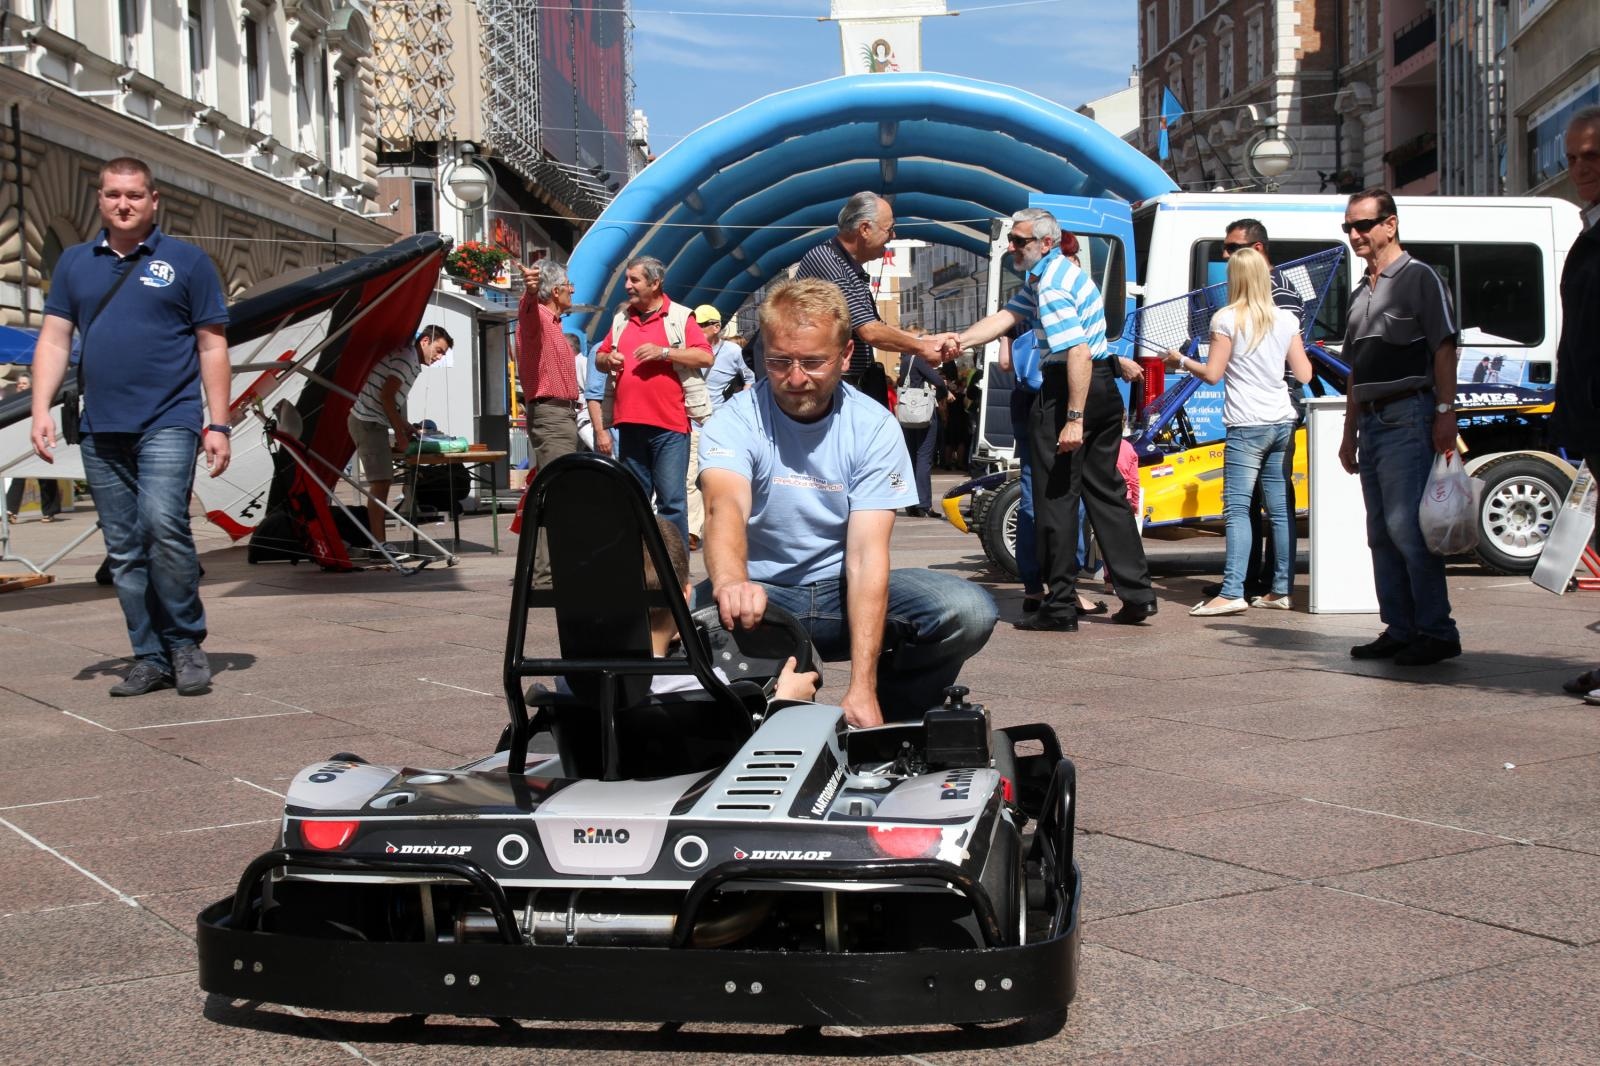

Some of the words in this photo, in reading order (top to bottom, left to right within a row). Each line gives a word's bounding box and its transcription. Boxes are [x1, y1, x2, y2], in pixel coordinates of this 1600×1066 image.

[1454, 393, 1518, 403] LMES
[1209, 450, 1223, 459] Ro
[399, 845, 472, 856] DUNLOP
[749, 850, 832, 861] DUNLOP
